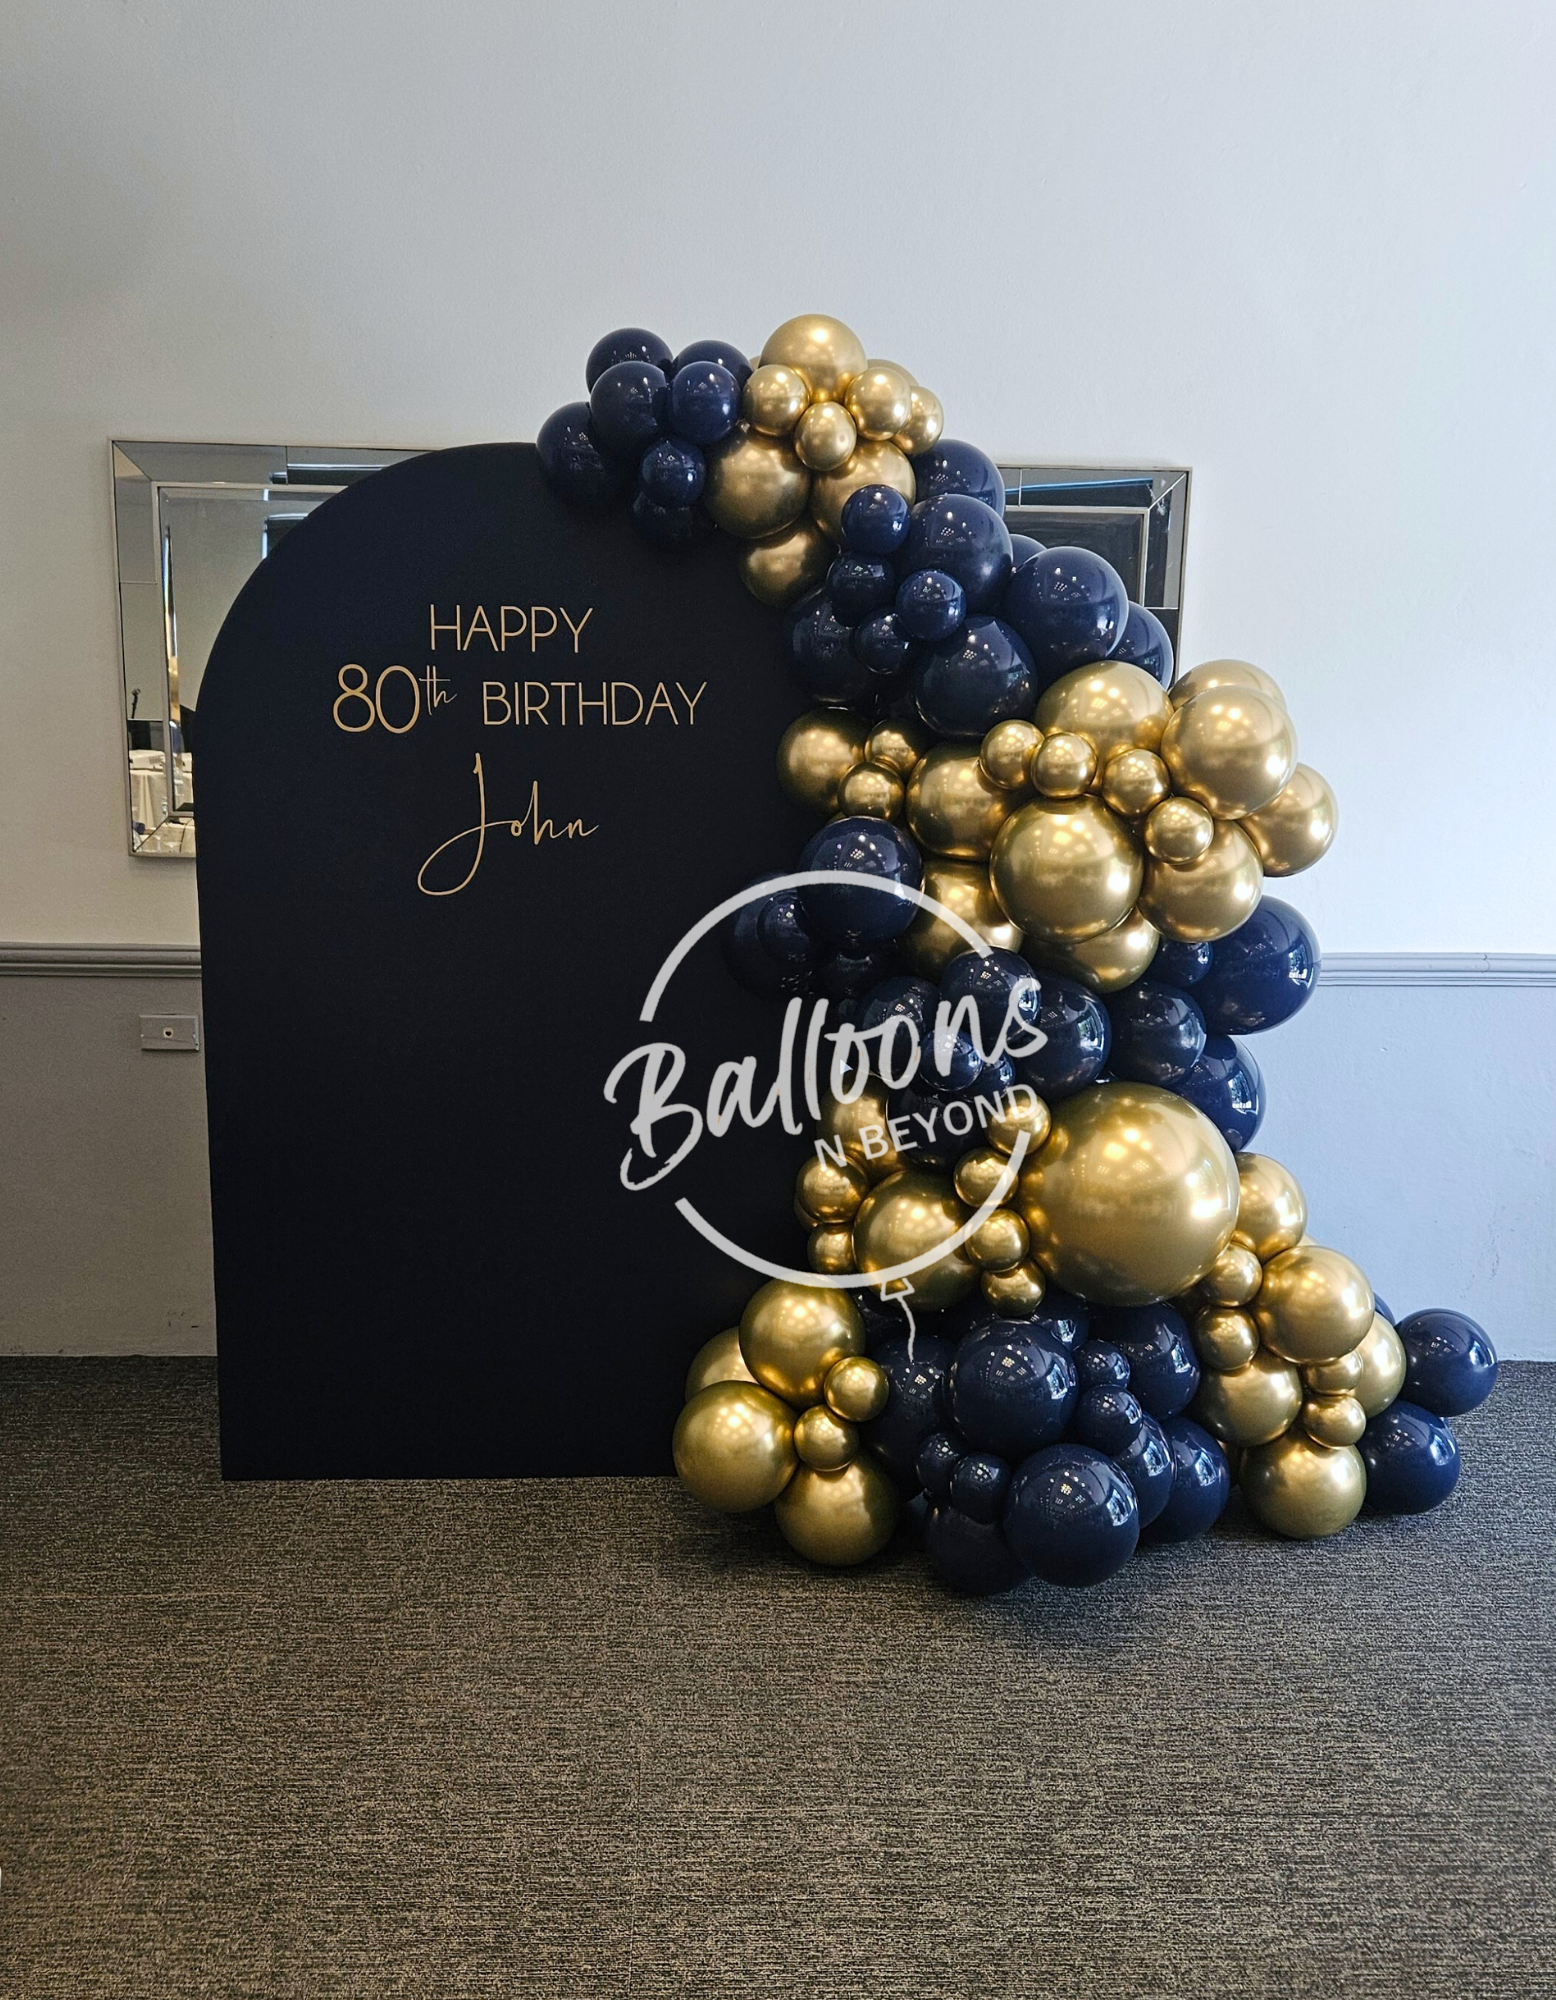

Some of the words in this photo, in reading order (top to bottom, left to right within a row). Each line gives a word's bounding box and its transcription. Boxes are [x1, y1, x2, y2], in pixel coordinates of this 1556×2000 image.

[431, 604, 592, 653] HAPPY
[333, 664, 457, 733] 80th
[483, 682, 707, 725] BIRTHDAY
[418, 753, 599, 895] John
